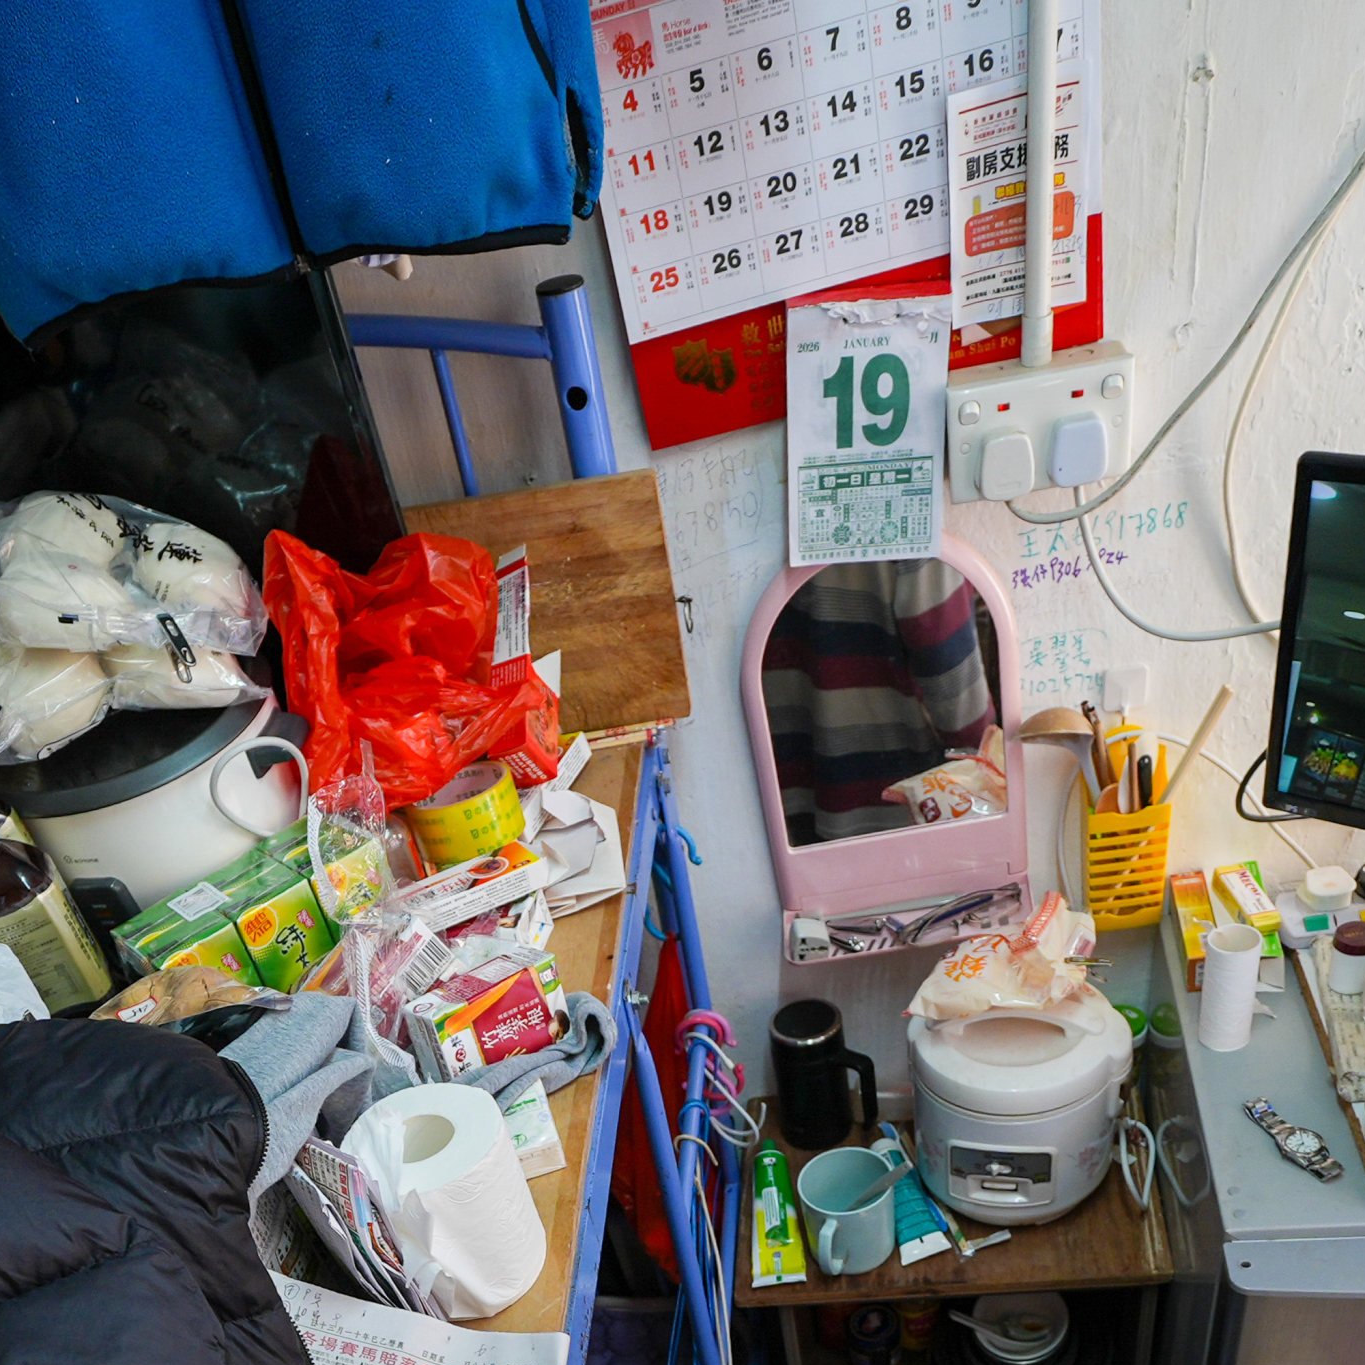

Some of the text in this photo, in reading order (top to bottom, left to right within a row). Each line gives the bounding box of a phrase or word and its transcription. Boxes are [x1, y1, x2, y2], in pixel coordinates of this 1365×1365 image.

[895, 6, 912, 31] 8
[825, 26, 840, 51] 7
[757, 47, 773, 72] 6
[964, 49, 994, 77] 16
[689, 68, 705, 93] 5
[895, 70, 925, 98] 15
[623, 89, 638, 112] 4
[827, 90, 857, 117] 14
[759, 110, 790, 137] 13
[693, 130, 724, 158] 12
[899, 133, 930, 162] 22
[628, 150, 656, 177] 11
[832, 153, 861, 180] 21
[966, 134, 1069, 182] 劏房支援務
[766, 172, 797, 198] 20
[704, 191, 732, 216] 19
[904, 194, 934, 221] 29
[640, 209, 669, 235] 18
[839, 213, 869, 238] 28
[775, 229, 803, 256] 27
[712, 249, 742, 275] 26
[650, 266, 679, 293] 25
[797, 342, 820, 353] 2026
[843, 336, 891, 349] JANUARY
[919, 332, 939, 344] 一月
[1000, 336, 1016, 348] Po
[823, 353, 911, 450] 19
[866, 461, 911, 471] MONDAY
